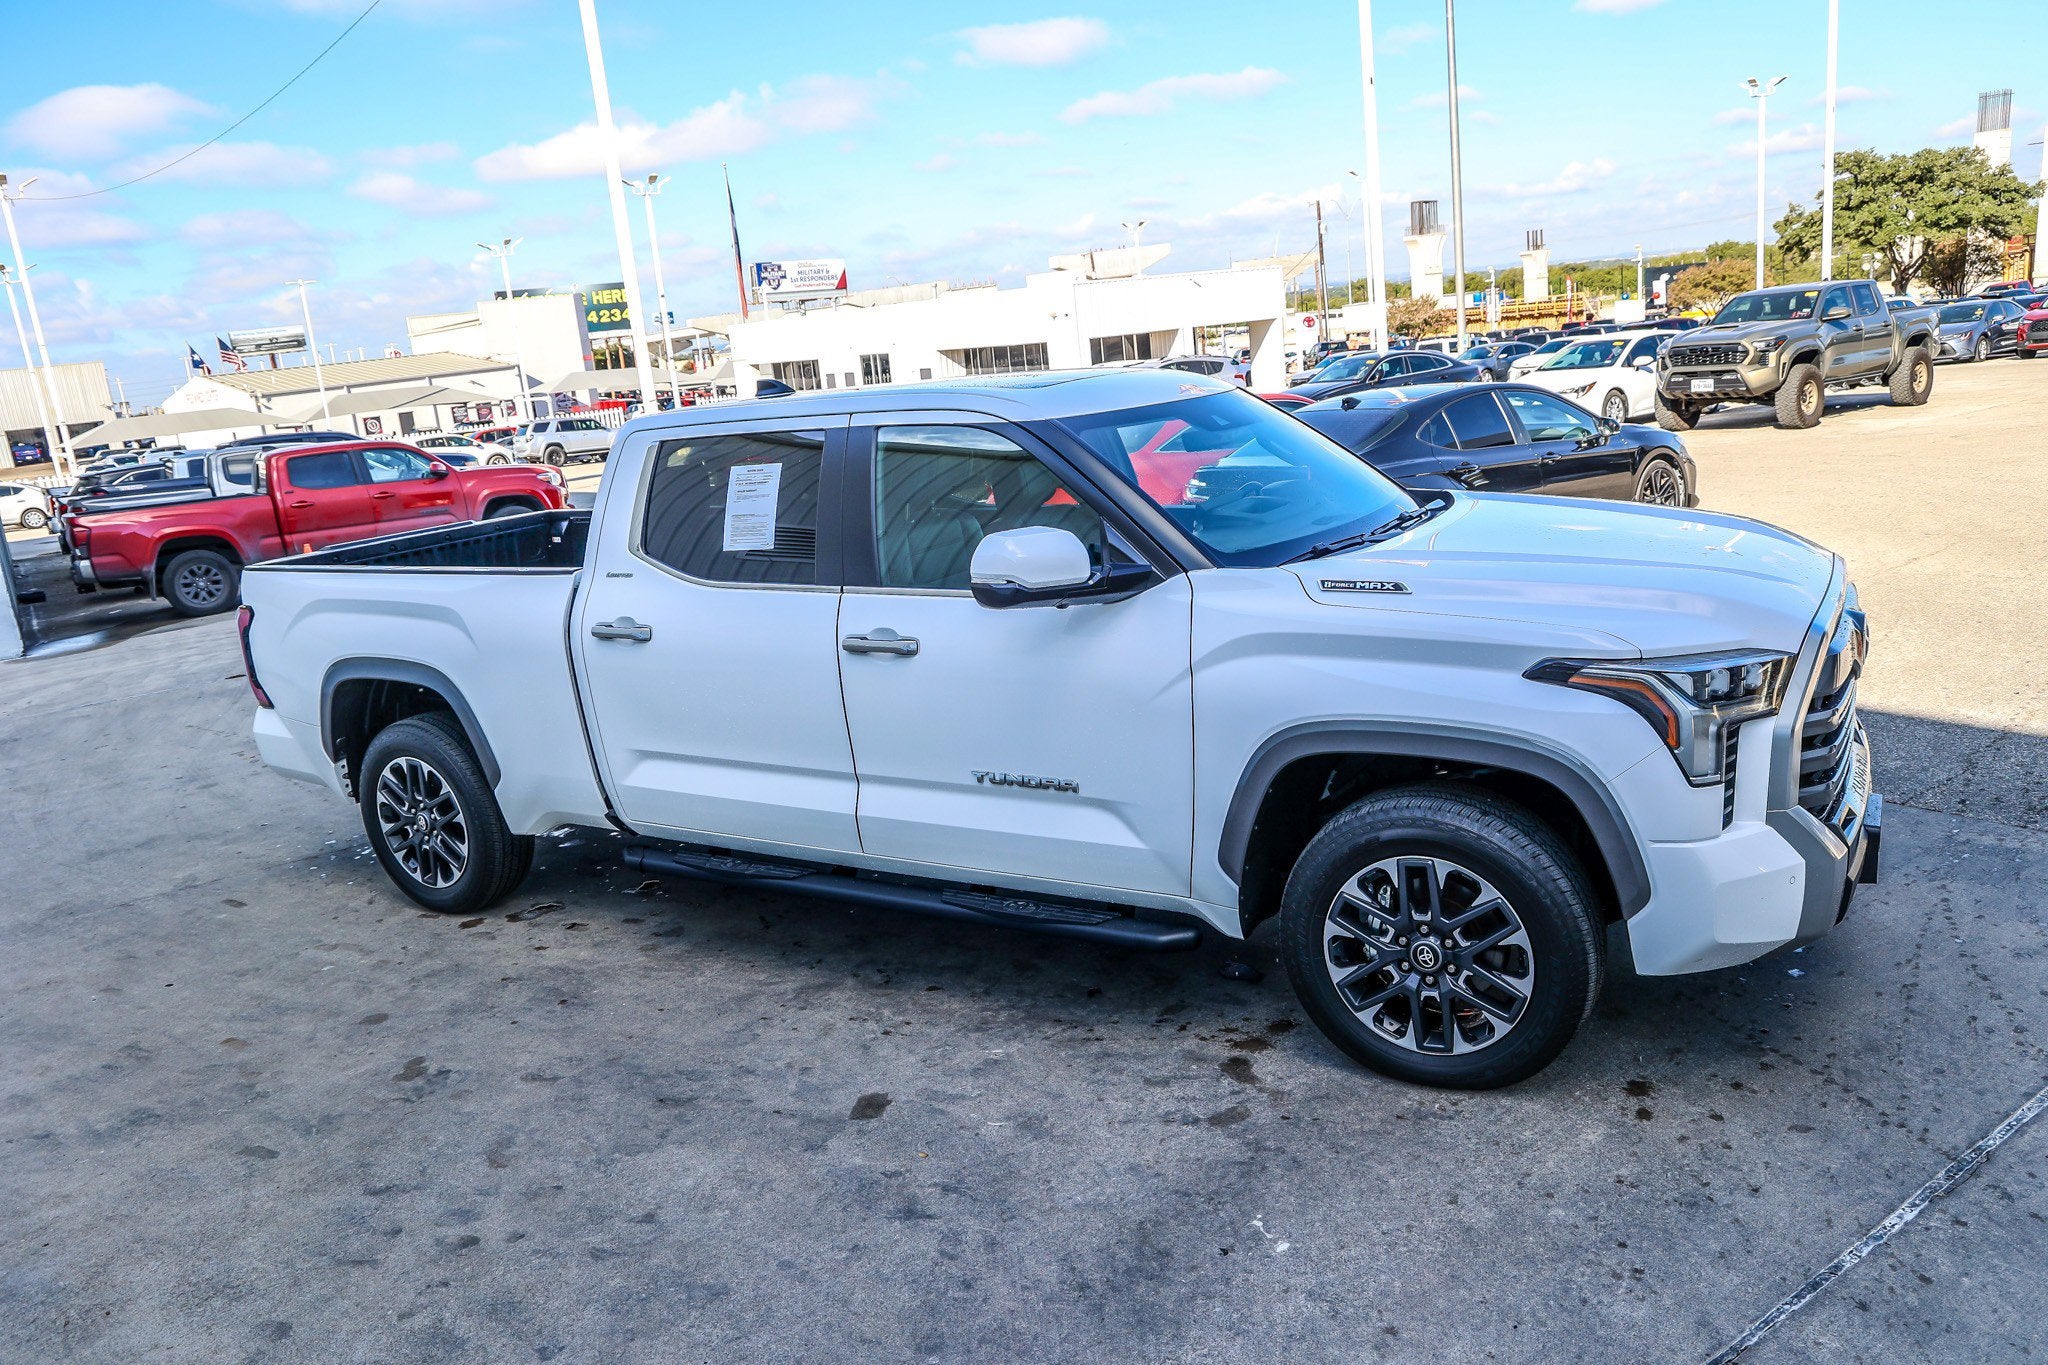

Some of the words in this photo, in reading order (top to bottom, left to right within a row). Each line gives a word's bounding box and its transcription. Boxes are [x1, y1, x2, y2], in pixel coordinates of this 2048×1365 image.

[797, 268, 825, 276] MILITARY
[799, 274, 838, 283] RESPONDERS
[1356, 581, 1395, 590] MAX
[971, 769, 1079, 794] TUNDRA
